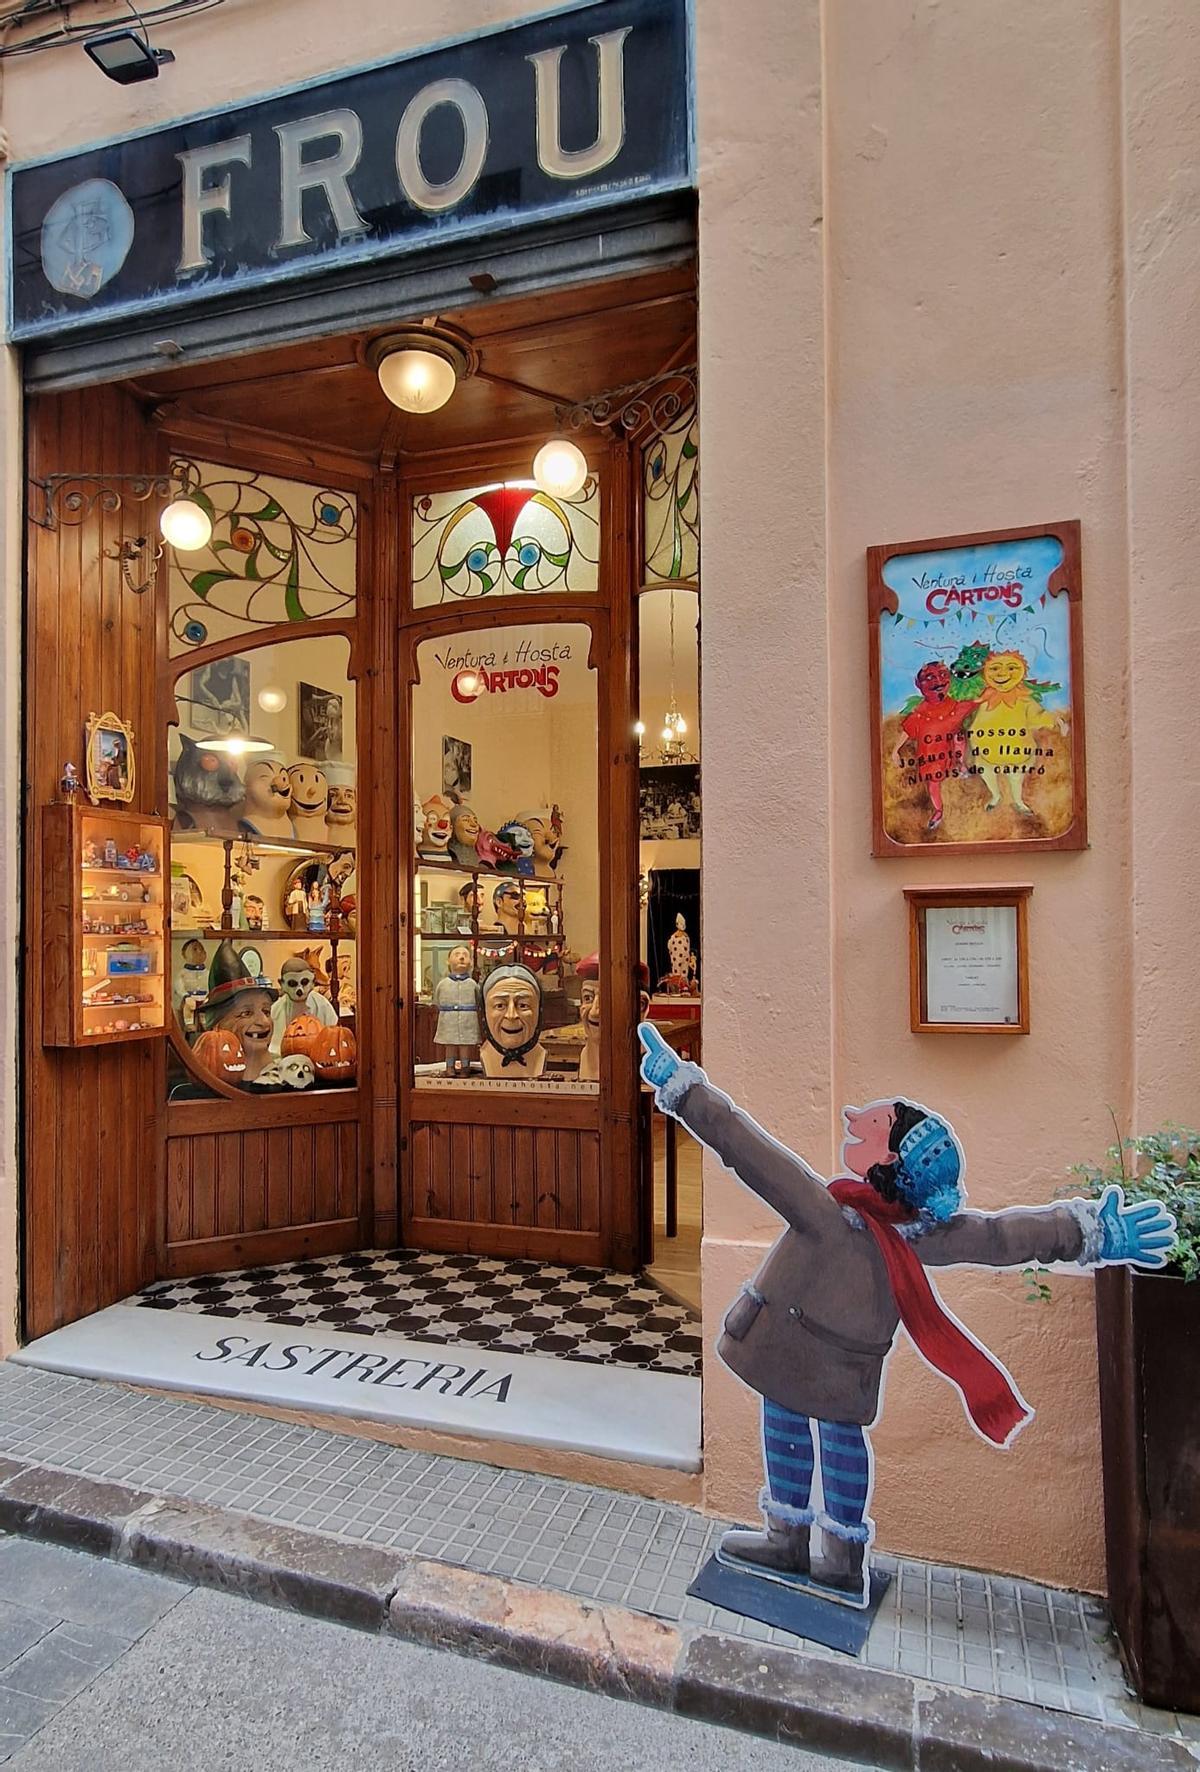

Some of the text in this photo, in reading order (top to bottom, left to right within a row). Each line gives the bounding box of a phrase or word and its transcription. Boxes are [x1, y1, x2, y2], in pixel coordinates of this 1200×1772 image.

[174, 26, 633, 273] FROU
[912, 571, 965, 589] Ventura
[984, 564, 1033, 583] Hosta
[926, 582, 1023, 615] CARTONS
[435, 647, 496, 669] Ventura
[515, 640, 572, 662] Hosta
[451, 663, 560, 704] CARTONS
[924, 727, 1027, 744] Capgrossos
[899, 745, 1054, 768] Joguets de llauna
[908, 768, 960, 785] Ninots
[968, 765, 985, 775] de
[426, 1080, 595, 1091] www.venturahosta.net
[194, 1336, 514, 1403] SASTRERIA
